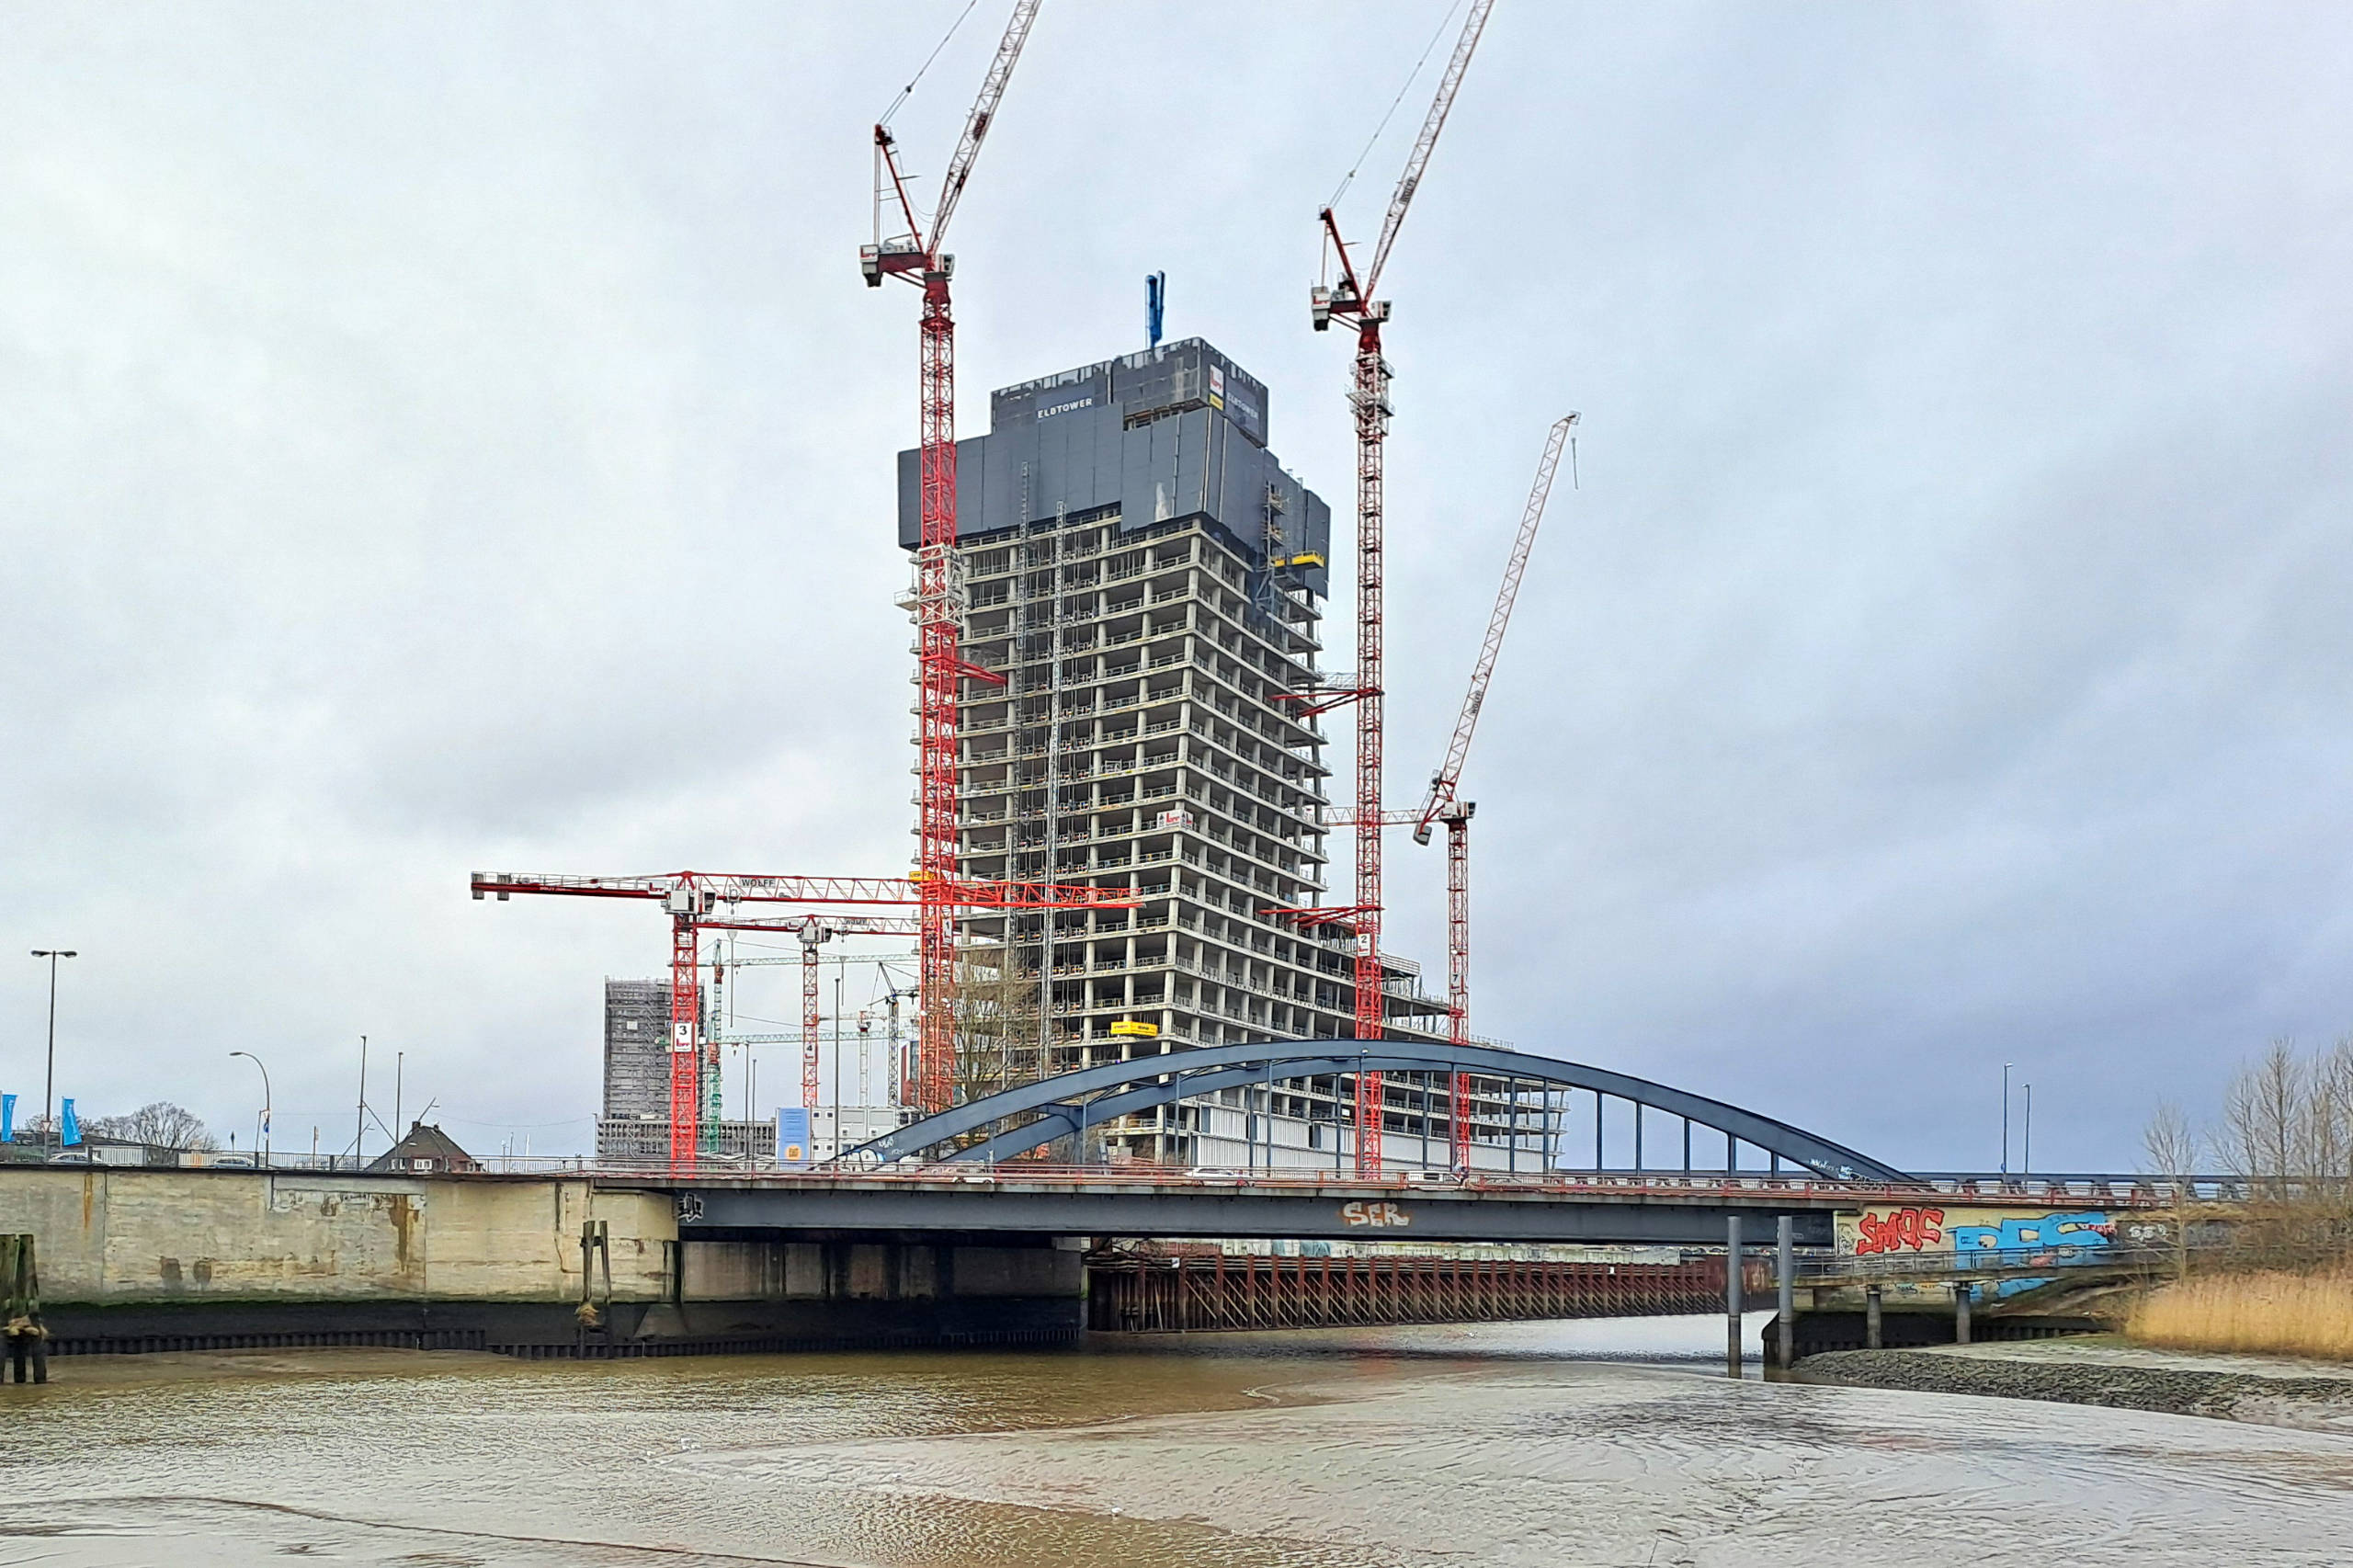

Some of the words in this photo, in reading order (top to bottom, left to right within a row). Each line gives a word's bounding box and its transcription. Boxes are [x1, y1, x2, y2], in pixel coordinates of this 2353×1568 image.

[1038, 398, 1093, 419] ELBTOWER
[741, 879, 776, 888] WOLFF
[1360, 935, 1368, 944] 2
[1452, 974, 1459, 983] 7
[678, 1025, 688, 1036] 3
[1343, 1202, 1410, 1228] SER
